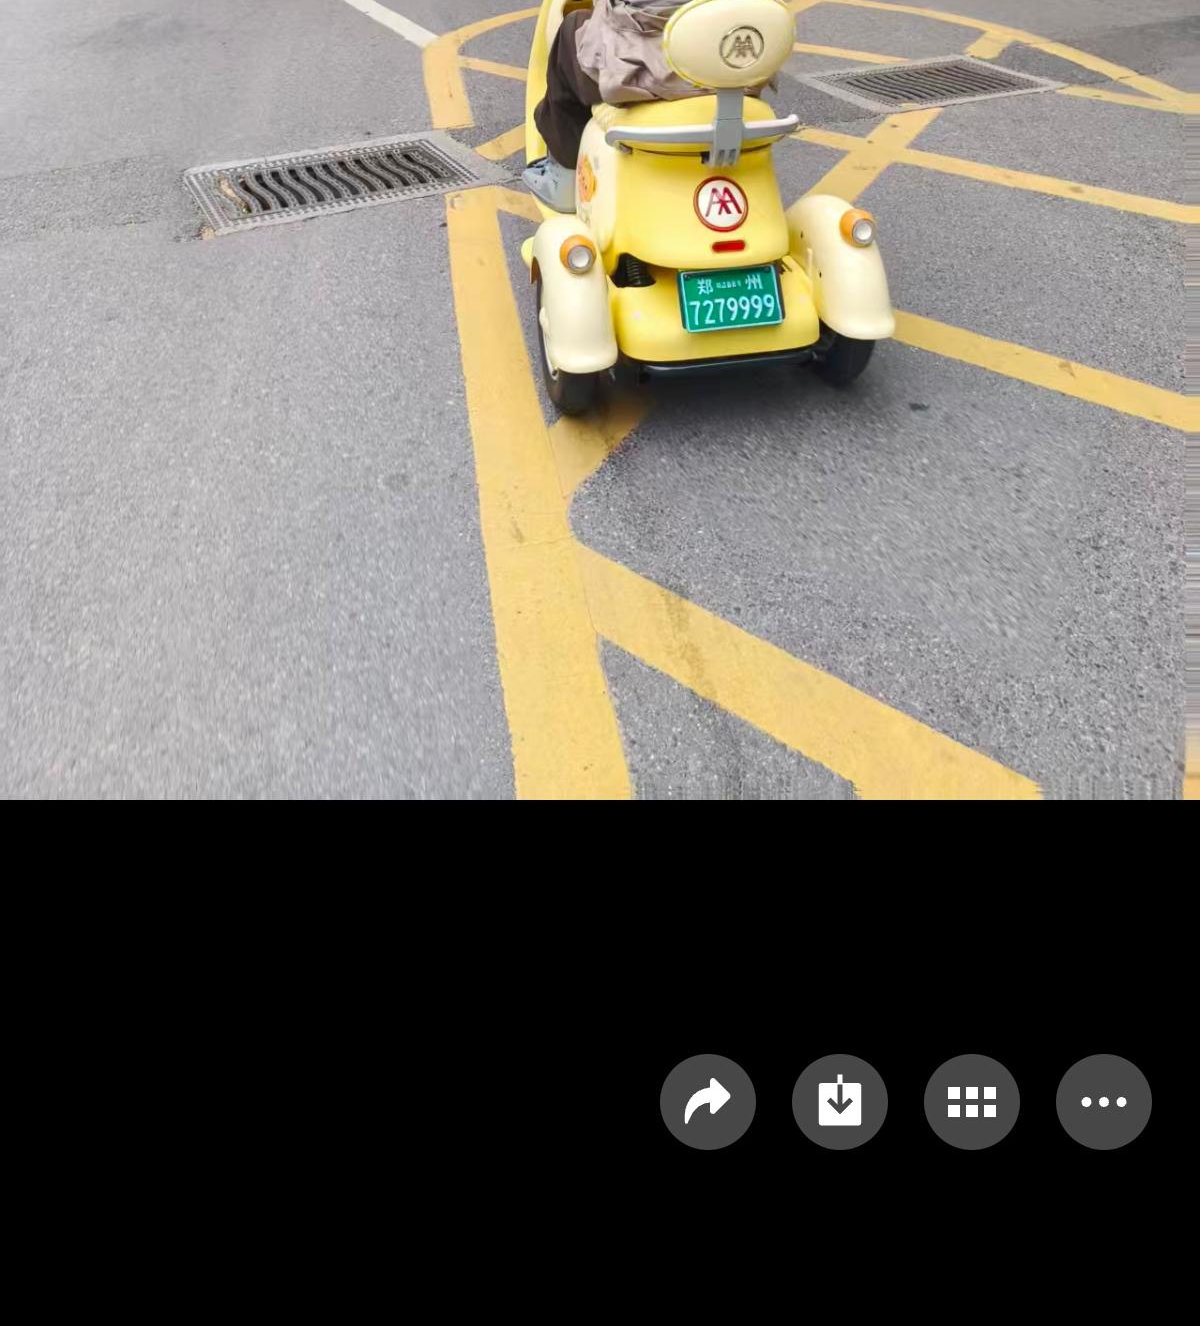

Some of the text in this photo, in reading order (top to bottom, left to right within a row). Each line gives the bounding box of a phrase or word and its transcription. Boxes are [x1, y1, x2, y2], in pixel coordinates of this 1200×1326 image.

[697, 278, 714, 295] 郑
[745, 274, 763, 290] 州
[689, 294, 775, 326] 7279999
